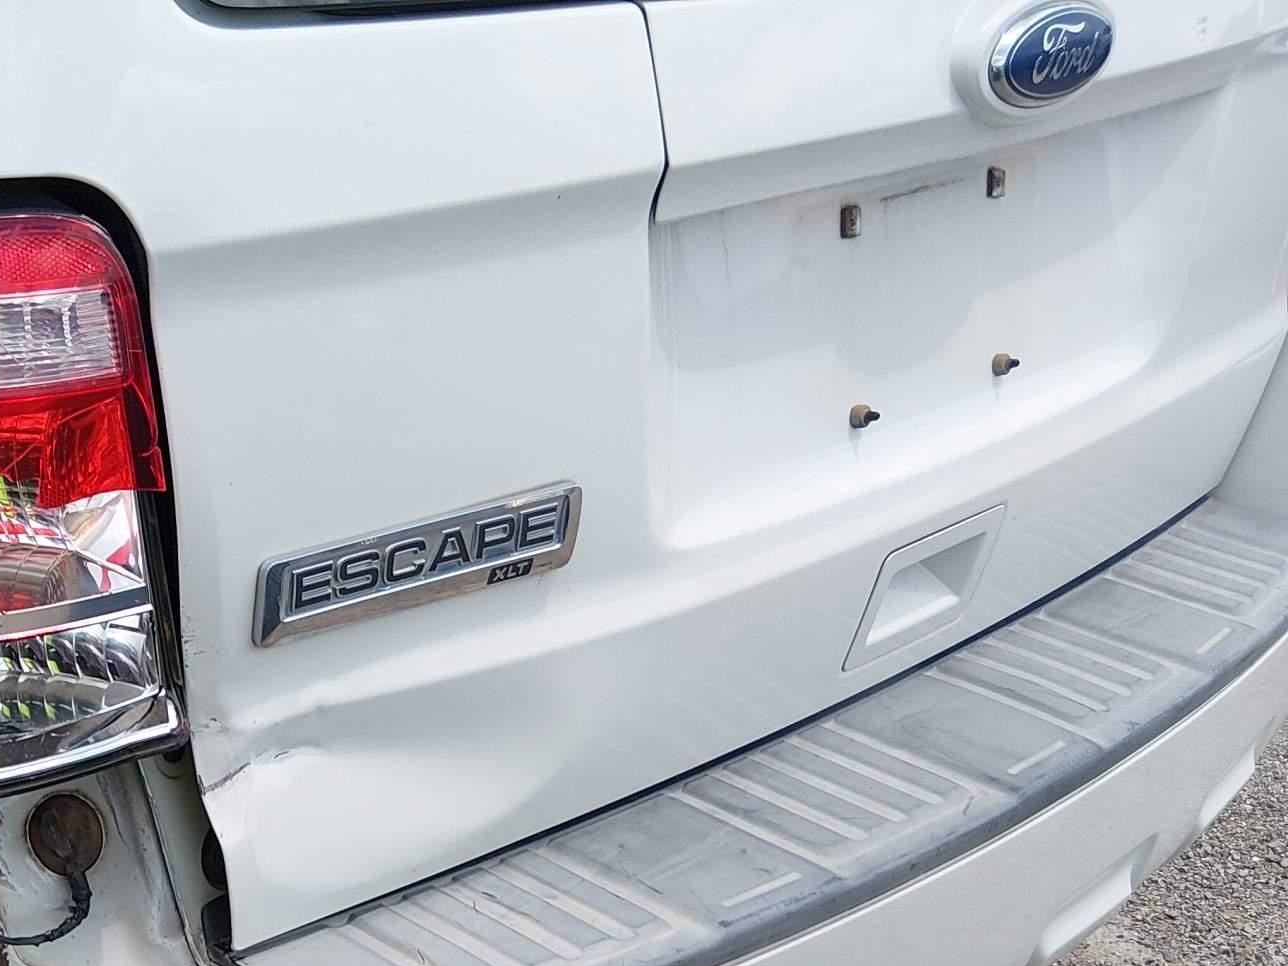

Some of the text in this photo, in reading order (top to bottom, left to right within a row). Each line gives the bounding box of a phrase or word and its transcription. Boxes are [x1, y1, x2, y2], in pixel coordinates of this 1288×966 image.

[1032, 20, 1100, 85] Ford
[290, 501, 561, 611] ESCAPE
[491, 560, 530, 583] XLT
